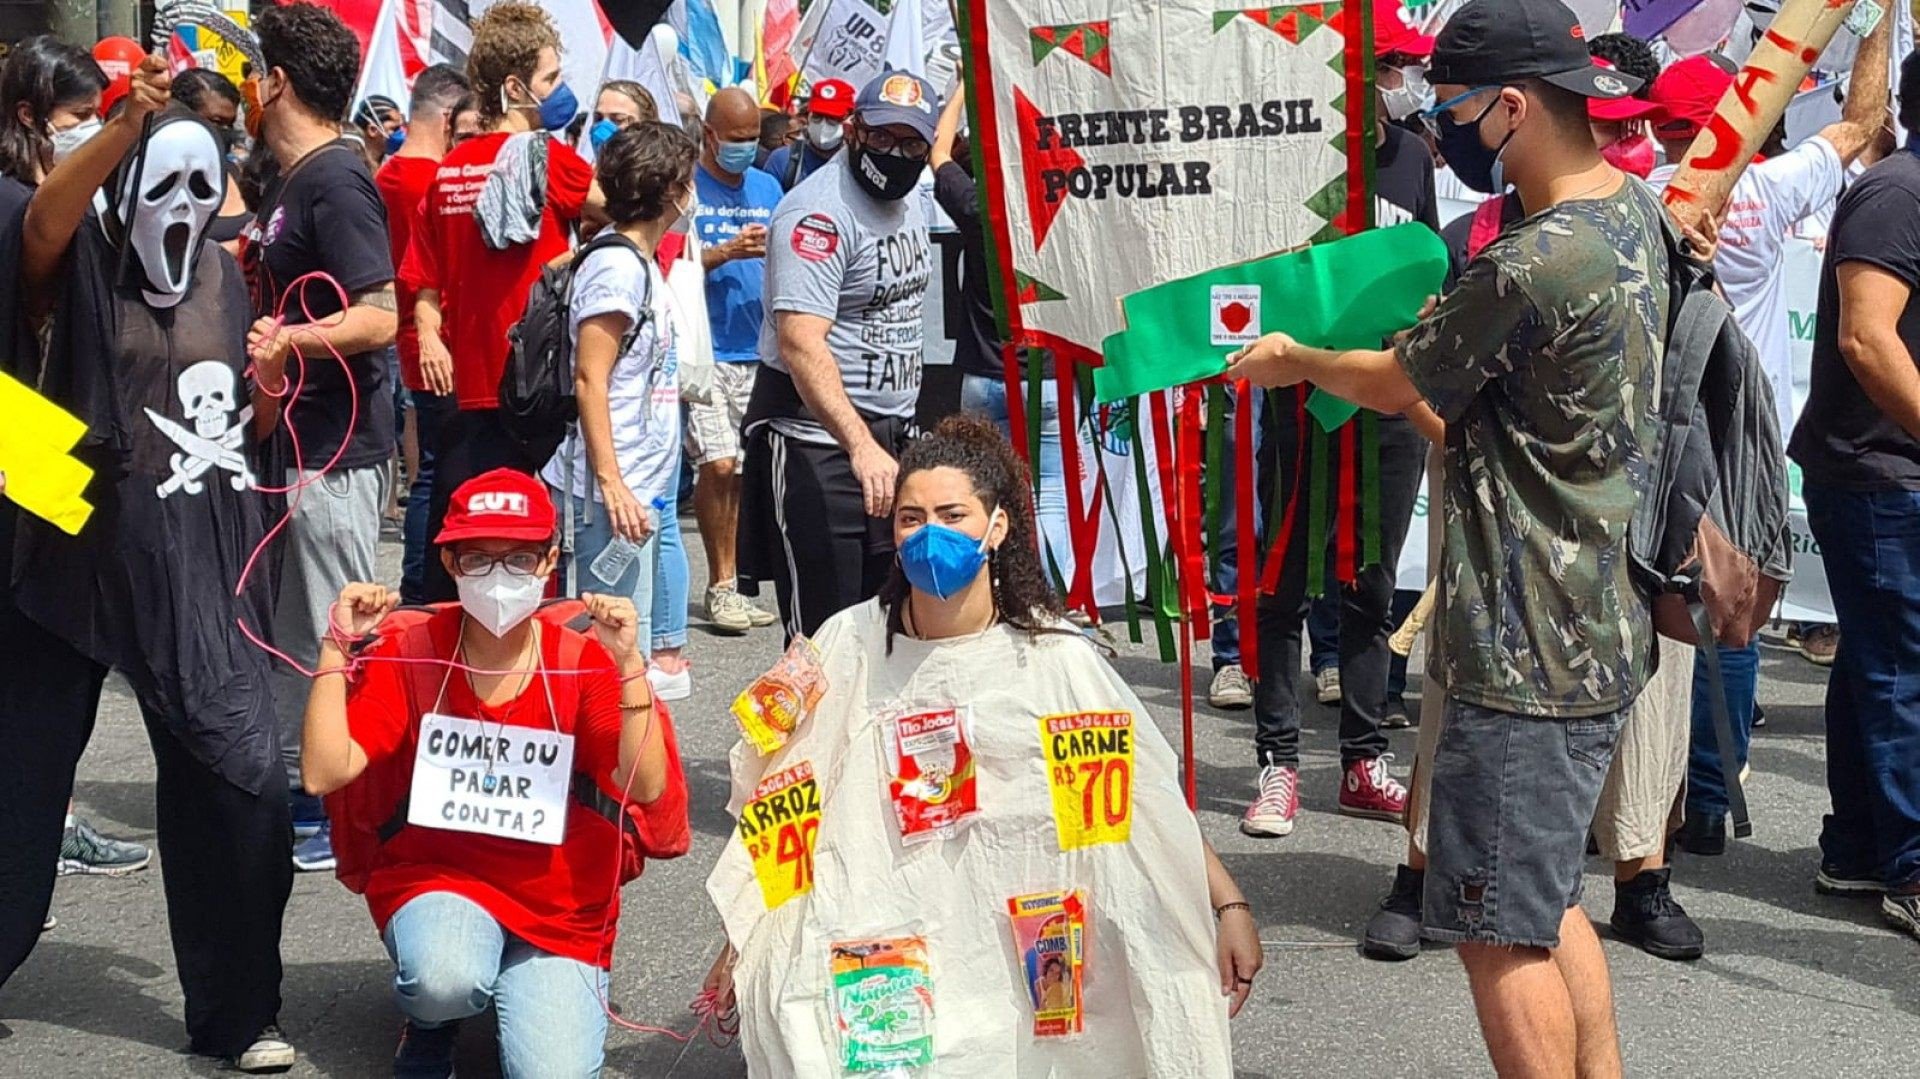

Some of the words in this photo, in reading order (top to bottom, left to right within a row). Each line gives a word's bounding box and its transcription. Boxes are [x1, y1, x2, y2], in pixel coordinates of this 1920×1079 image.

[845, 12, 876, 40] UP
[1036, 109, 1171, 150] FRENTE
[1179, 99, 1322, 143] BRASIL
[1042, 161, 1212, 203] POPULAR
[697, 204, 715, 216] Eu
[468, 492, 526, 513] CUT
[902, 721, 921, 734] Tio
[923, 715, 954, 731] João
[428, 729, 511, 763] COMER
[523, 742, 559, 766] OU
[1053, 730, 1130, 760] CARNE
[740, 779, 820, 839] ARROZ
[1054, 763, 1076, 787] R$
[1079, 758, 1129, 831] 70
[749, 835, 771, 861] R$
